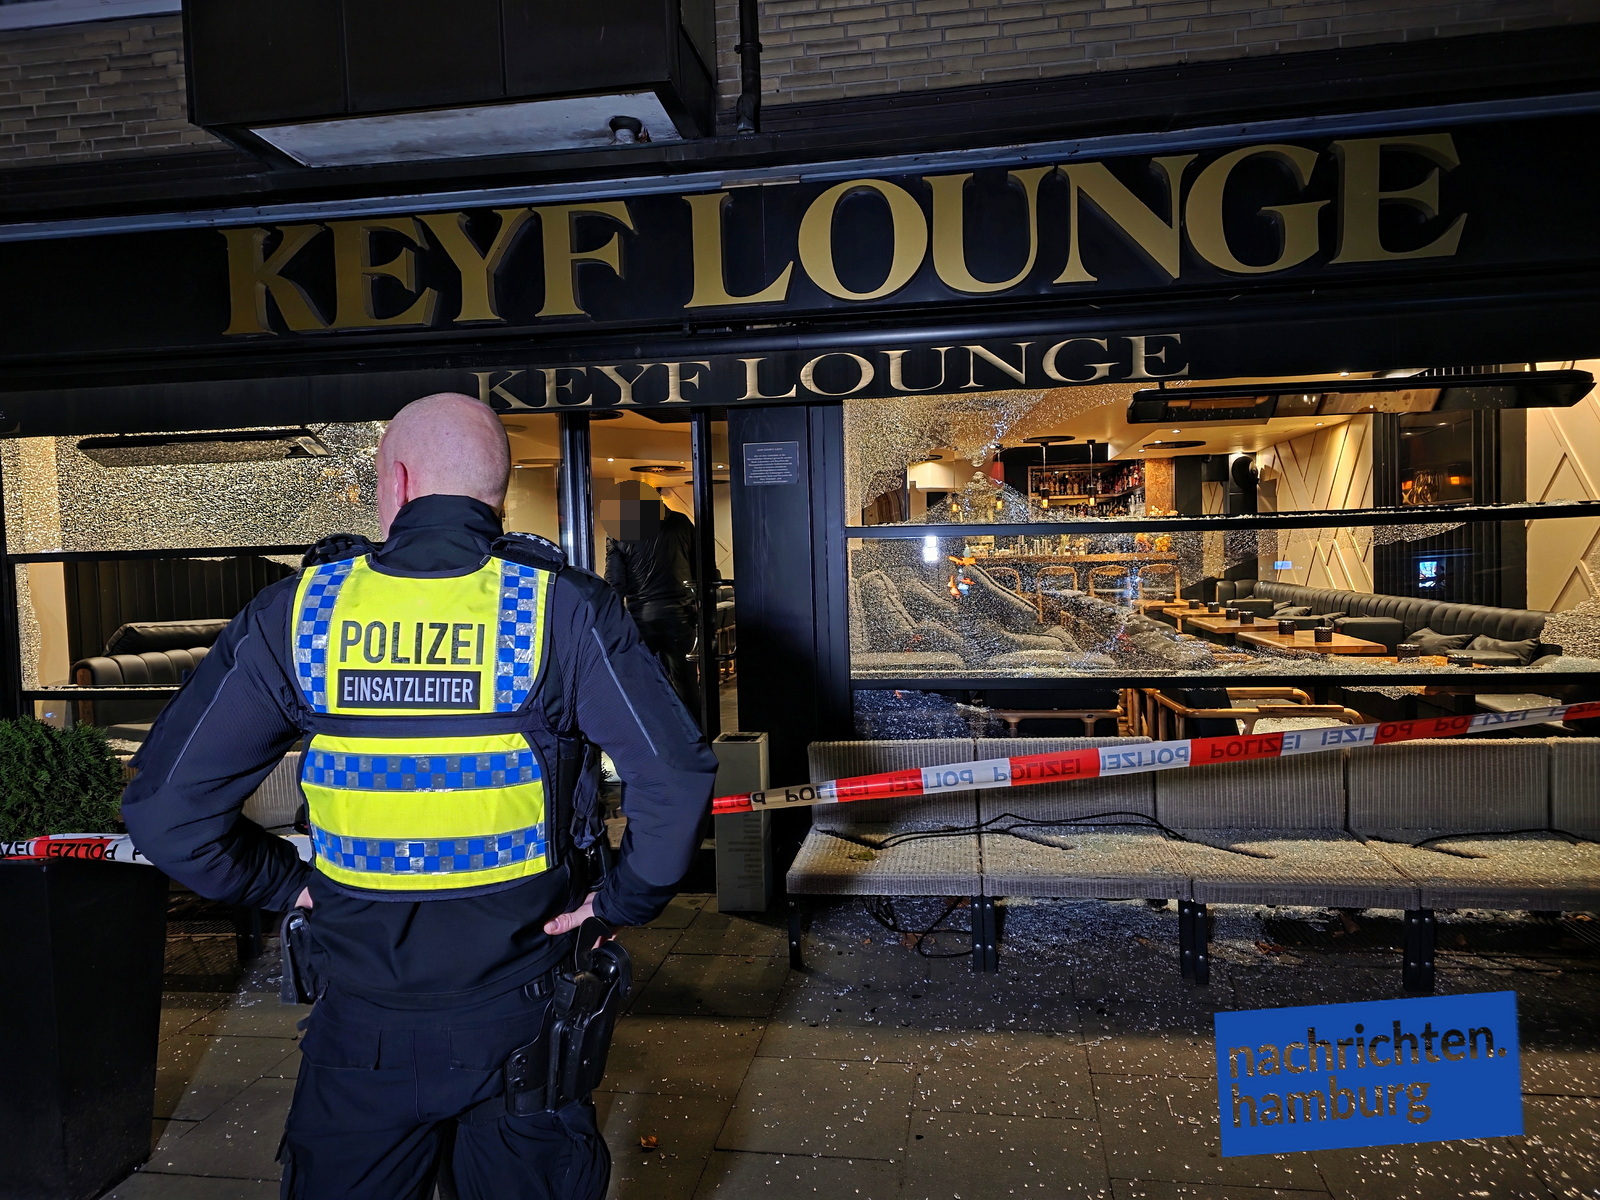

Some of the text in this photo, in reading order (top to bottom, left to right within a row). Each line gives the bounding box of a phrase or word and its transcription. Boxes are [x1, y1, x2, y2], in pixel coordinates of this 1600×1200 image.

[218, 132, 1468, 337] KEYF LOUNGE
[471, 332, 1190, 410] KEYF LOUNGE
[339, 620, 486, 665] POLIZEI
[343, 676, 474, 703] EINSATZLEITER
[46, 843, 119, 860] POLIZEI
